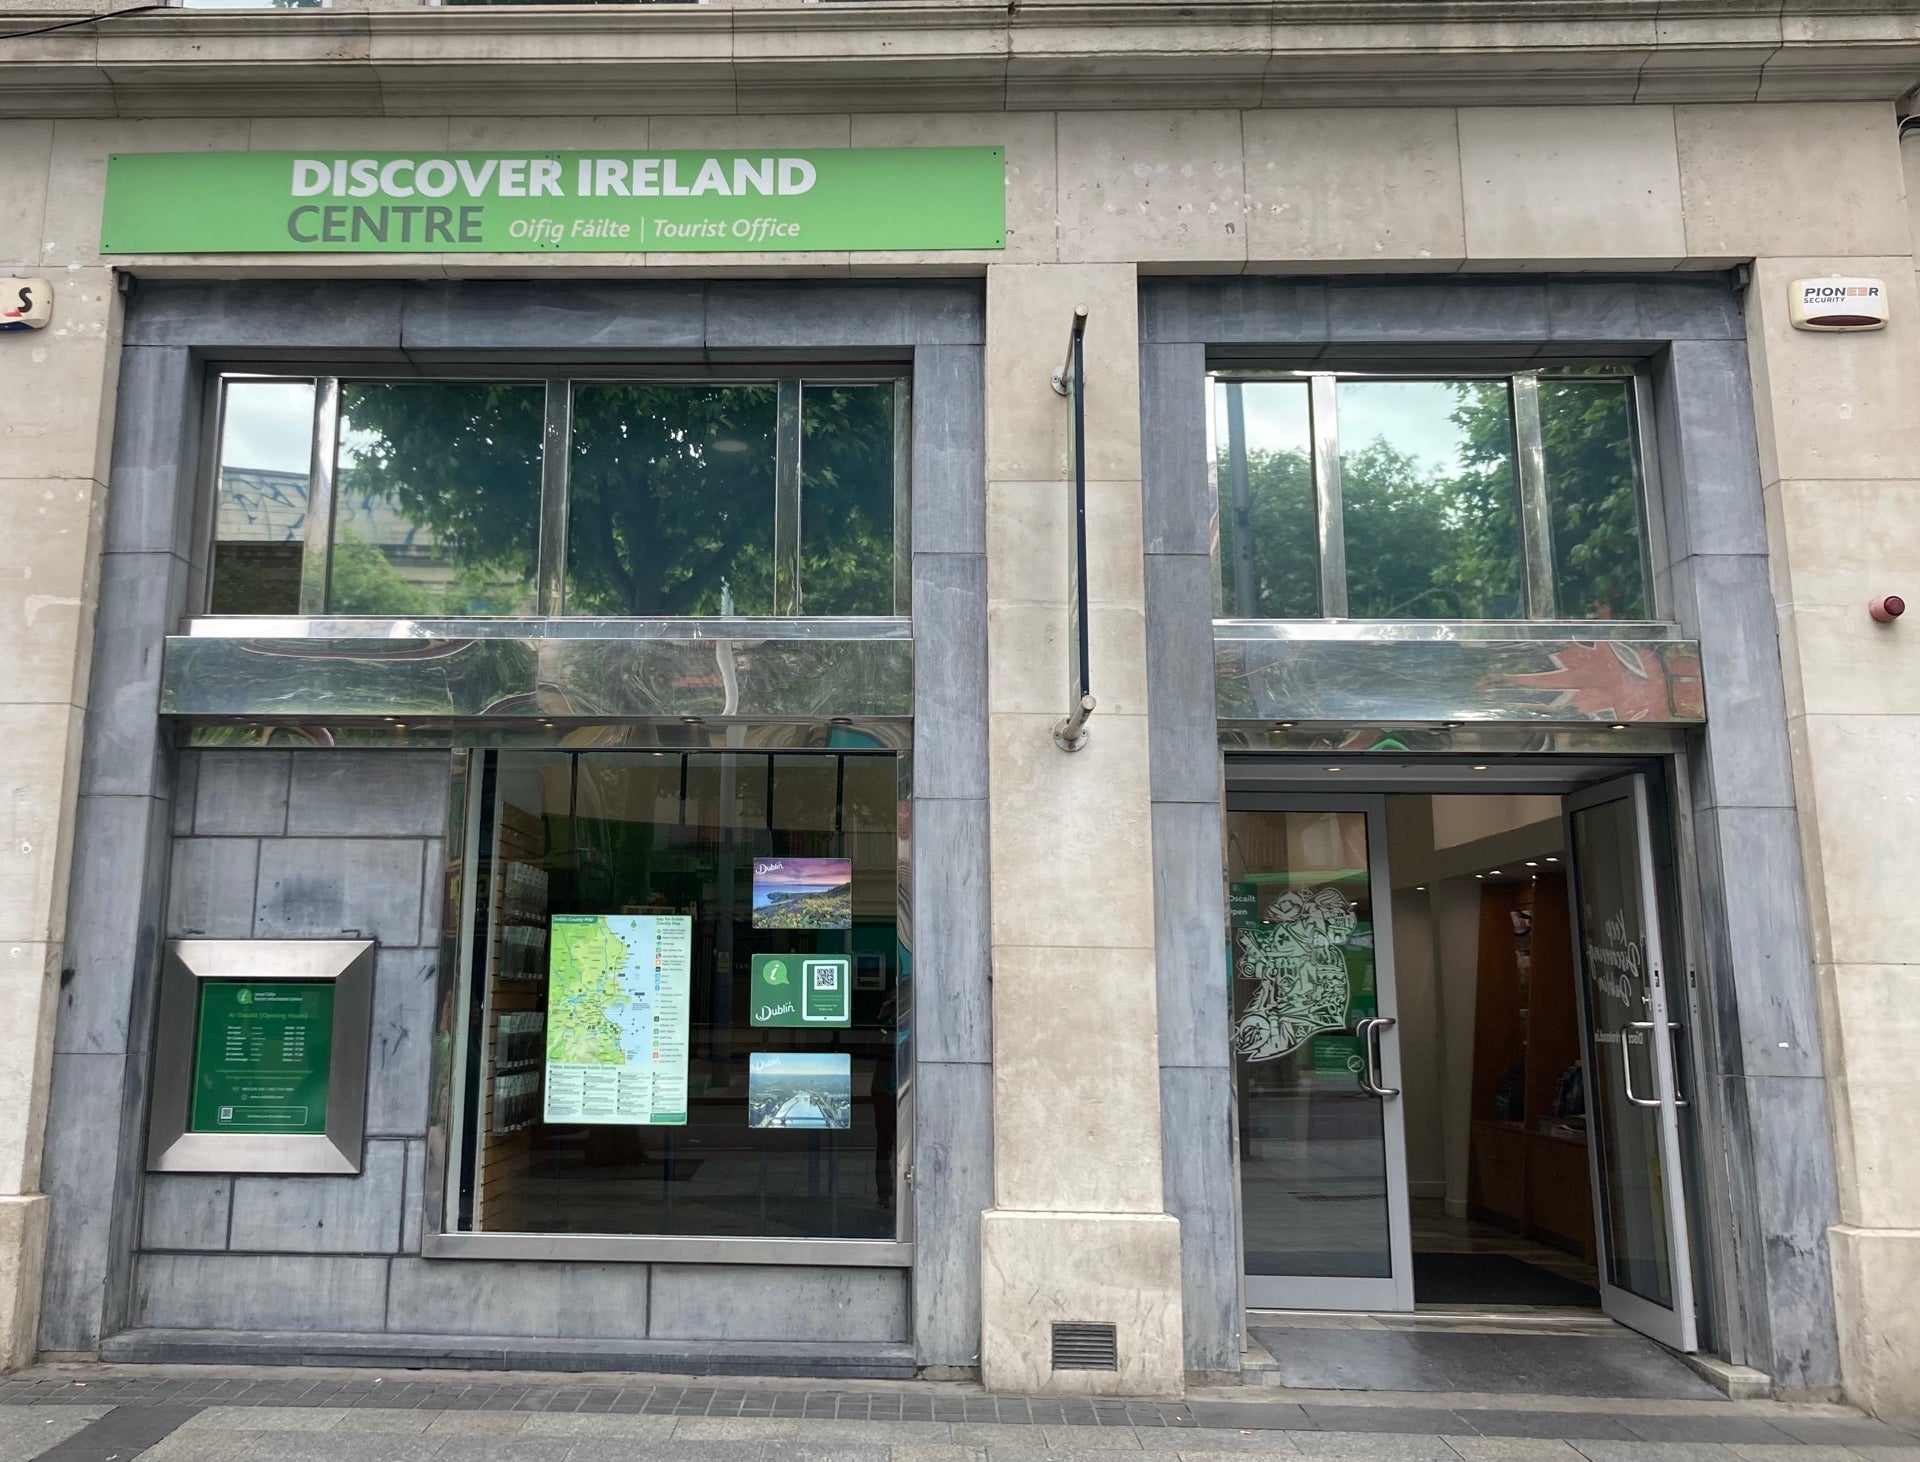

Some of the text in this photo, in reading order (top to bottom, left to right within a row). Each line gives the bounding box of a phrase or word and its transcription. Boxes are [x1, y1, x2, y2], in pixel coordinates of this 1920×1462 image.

[291, 157, 817, 197] DISCOVER IRELAND
[287, 205, 484, 243] CENTRE
[508, 216, 801, 245] Oifig Fáilte Tourist Office
[1804, 287, 1879, 297] PIONEER
[755, 860, 784, 876] Dublin
[755, 1000, 796, 1022] Dublin
[751, 1056, 781, 1072] Dublin
